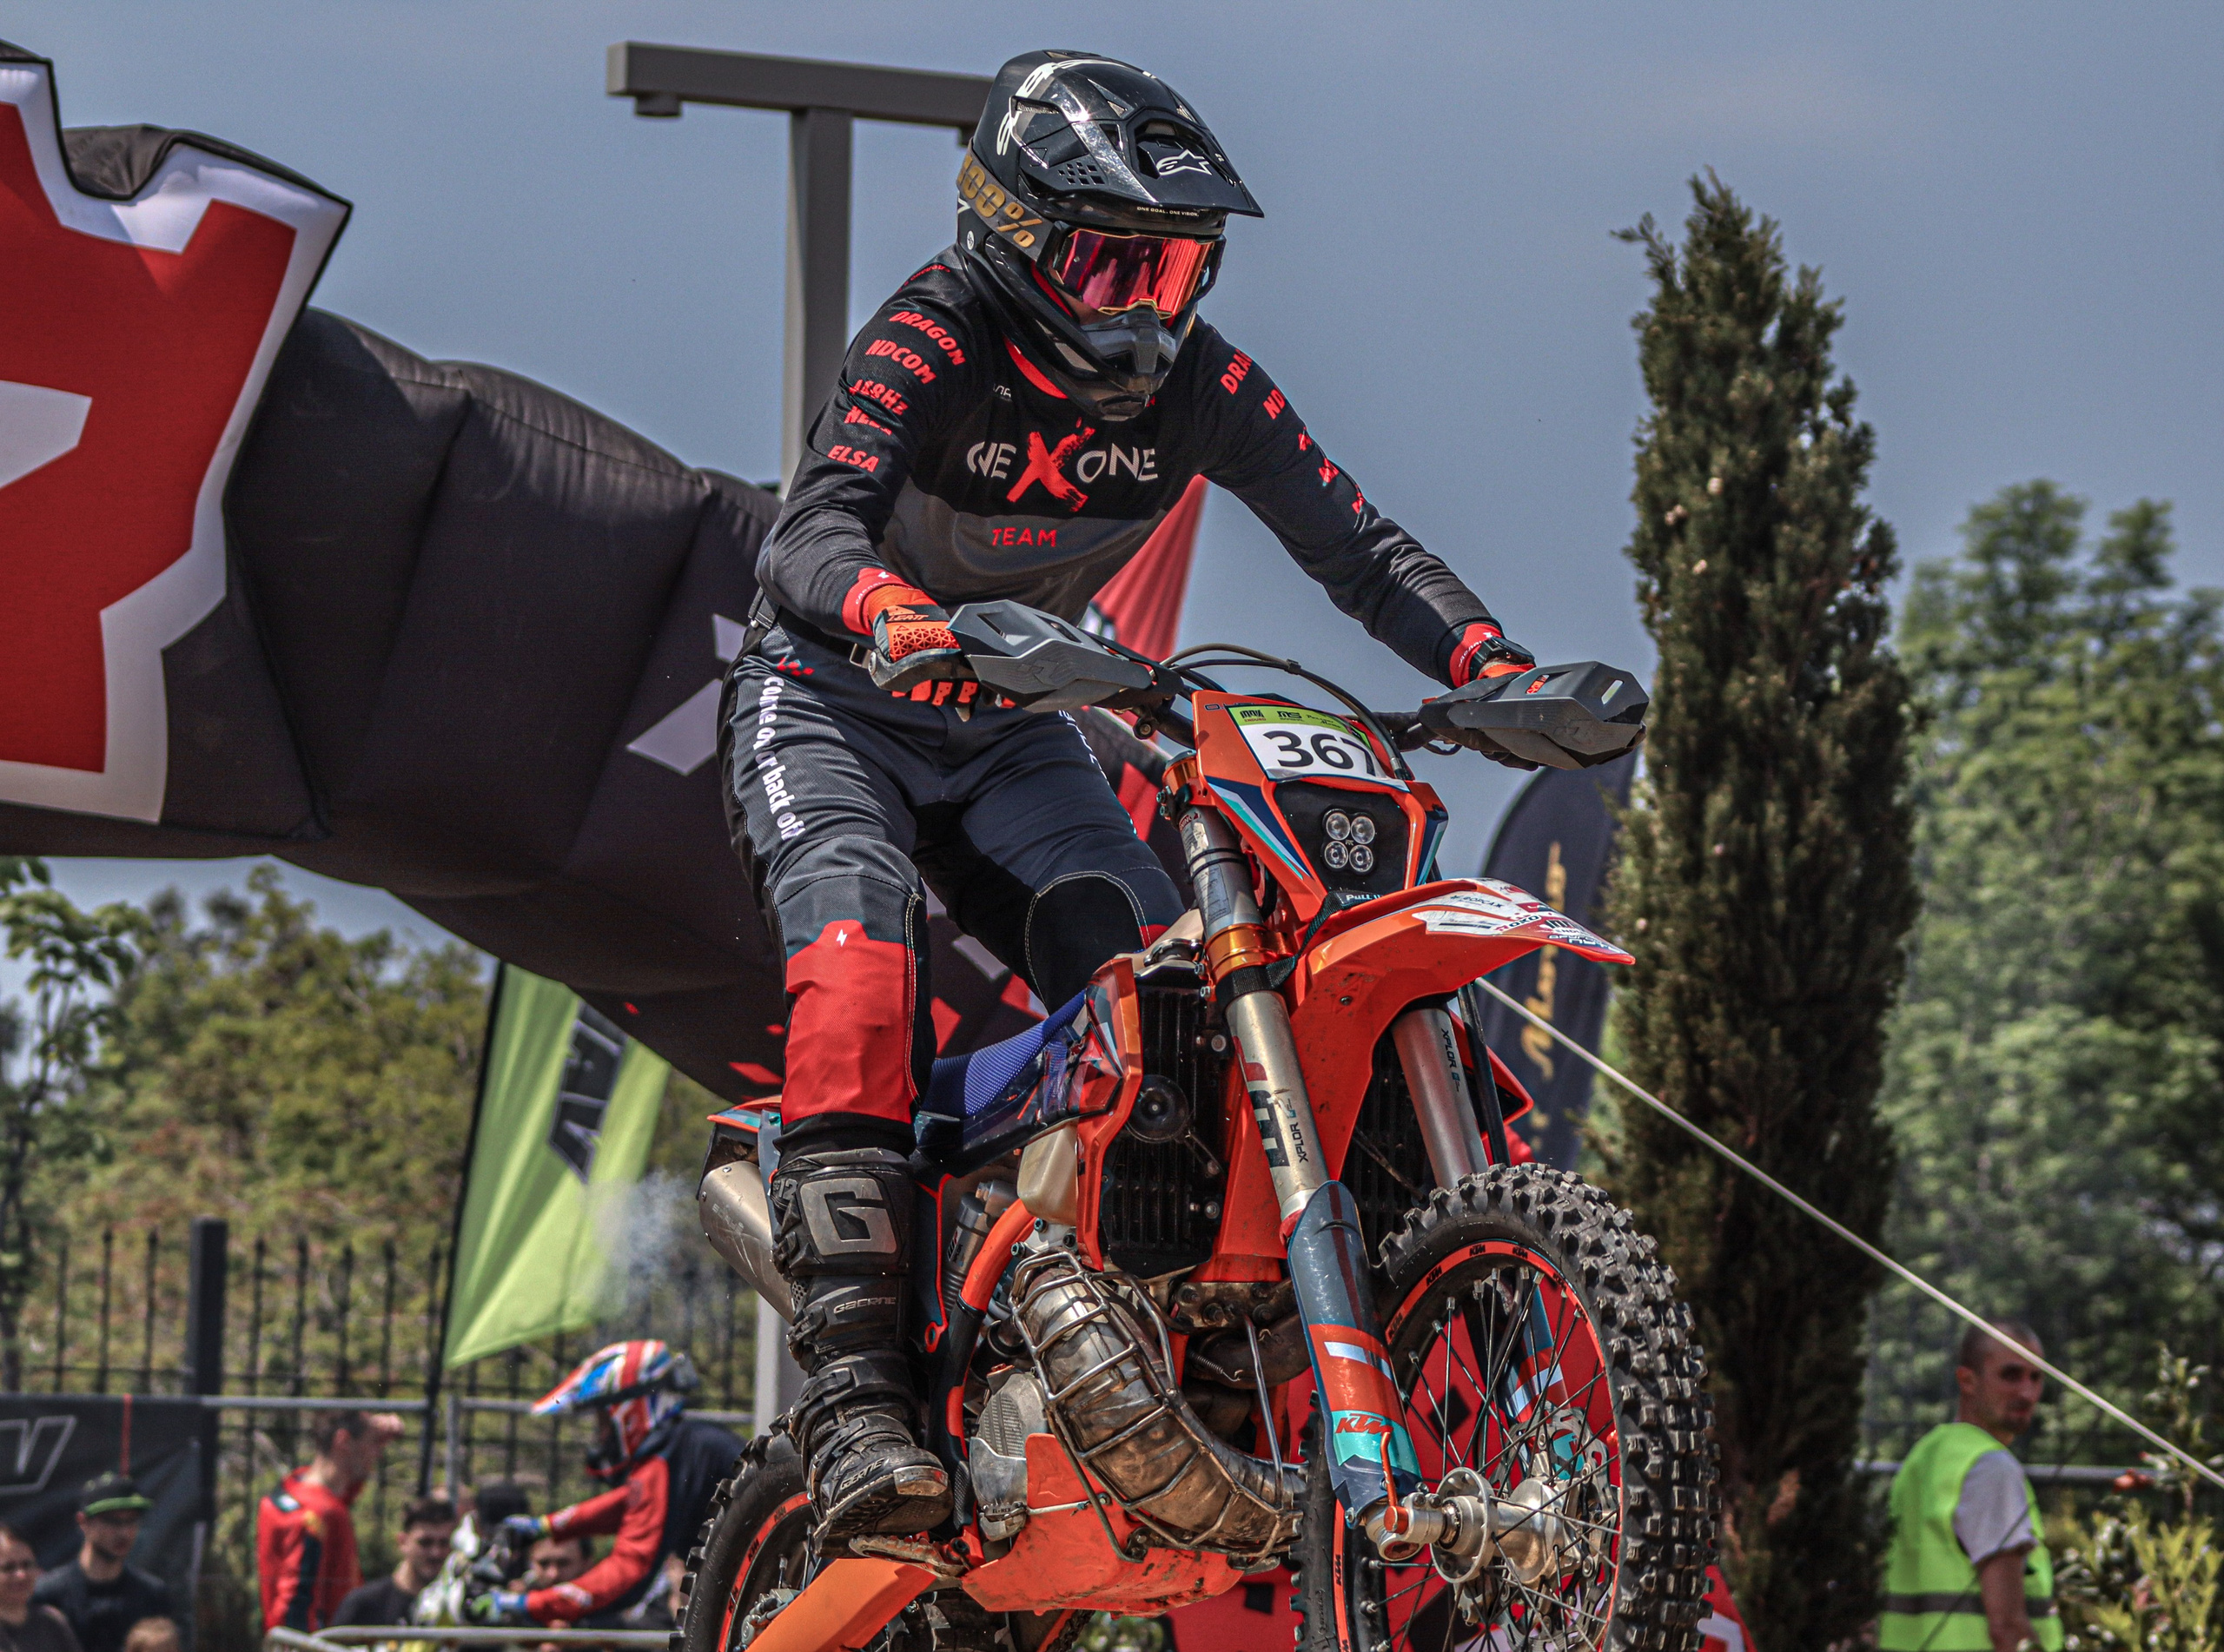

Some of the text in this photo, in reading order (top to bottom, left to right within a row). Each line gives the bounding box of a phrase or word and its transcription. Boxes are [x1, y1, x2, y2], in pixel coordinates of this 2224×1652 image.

[889, 311, 966, 366] DRAGON
[864, 339, 937, 384] NDCOM
[827, 445, 879, 472] ELSA
[991, 527, 1057, 547] TEAM
[763, 765, 795, 815] back
[1440, 1028, 1457, 1067] XPLOR
[1289, 1121, 1309, 1164] XPLOR
[1469, 1244, 1486, 1257] KTM
[1512, 1246, 1529, 1259] KTM
[1426, 1265, 1442, 1287] KTM
[1334, 1412, 1394, 1436] KTM
[748, 1538, 760, 1563] KTM
